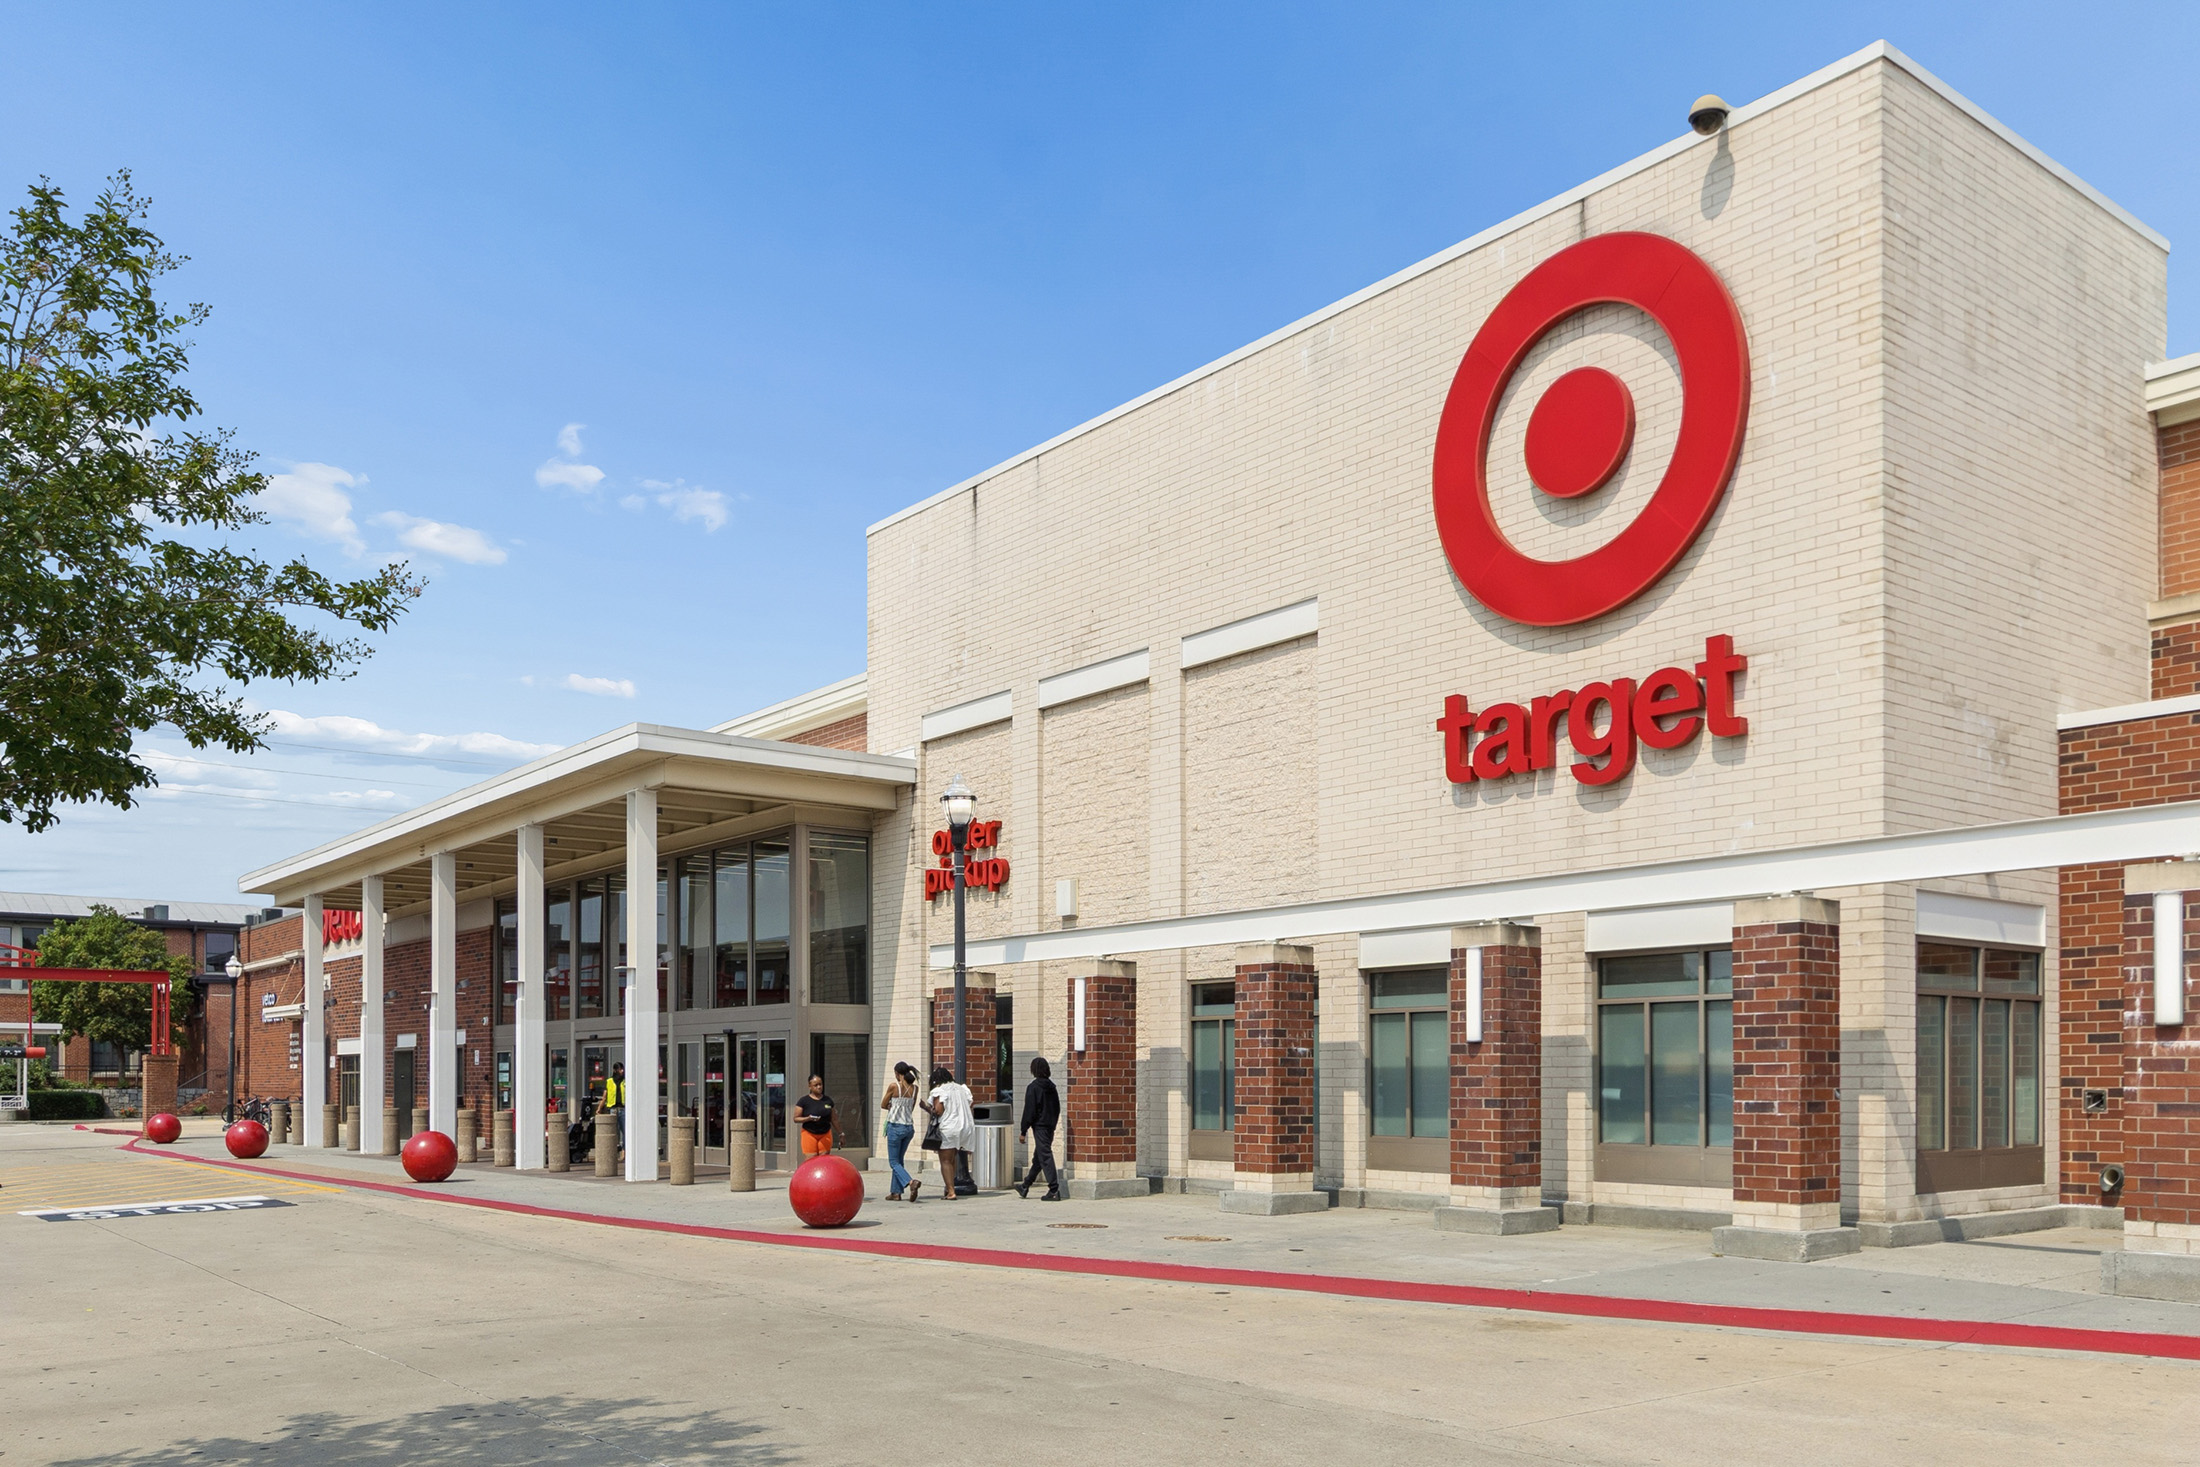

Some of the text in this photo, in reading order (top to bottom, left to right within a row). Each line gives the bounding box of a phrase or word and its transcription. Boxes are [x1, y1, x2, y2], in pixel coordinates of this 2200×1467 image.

[1437, 633, 1748, 786] target
[932, 817, 1002, 855] orer
[66, 1201, 264, 1220] STOP
